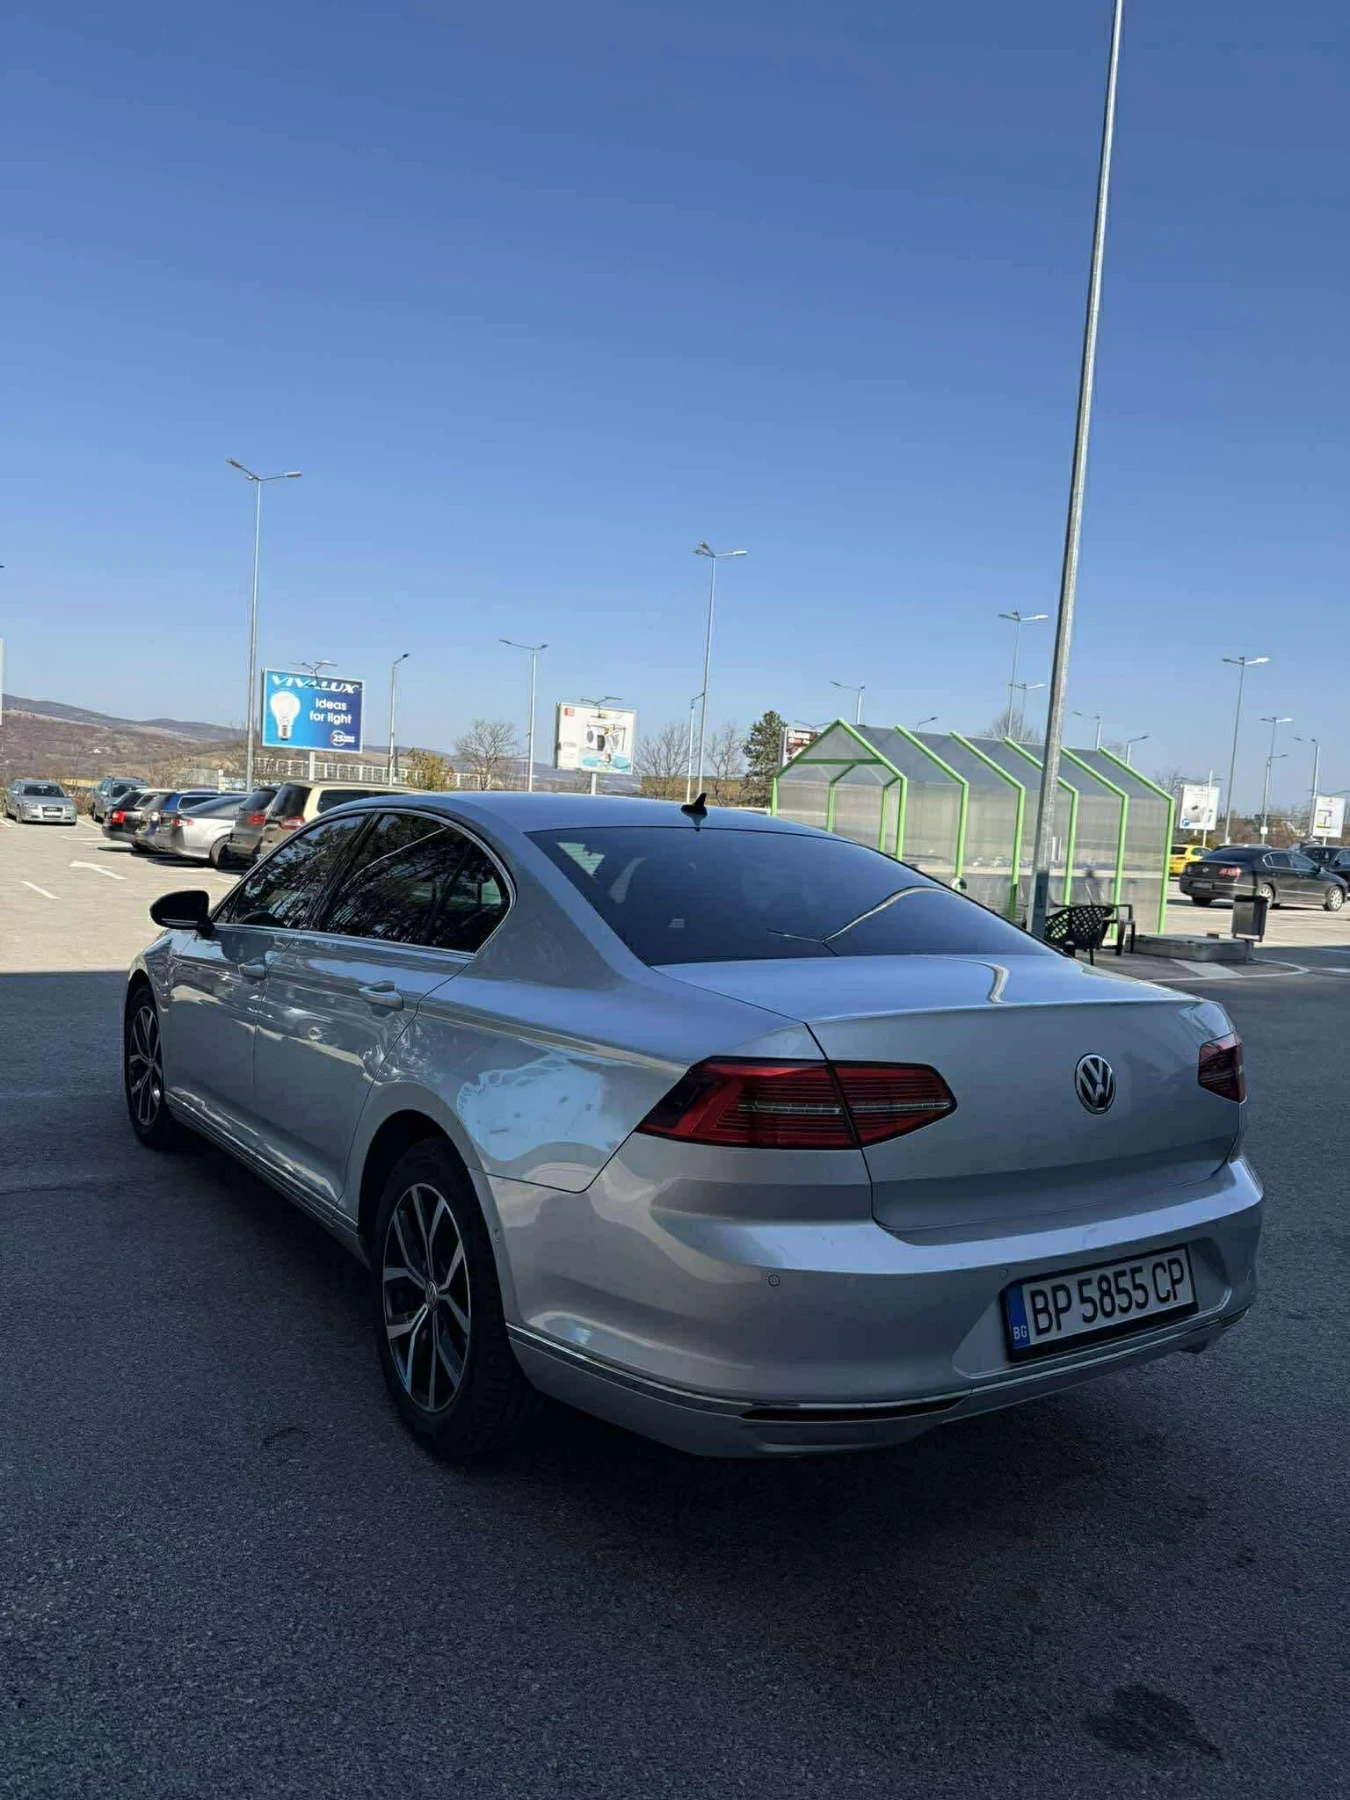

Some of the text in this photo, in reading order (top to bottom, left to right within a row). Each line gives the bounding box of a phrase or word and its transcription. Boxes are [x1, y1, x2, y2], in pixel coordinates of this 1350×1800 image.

[272, 674, 360, 694] VIVALUX
[309, 710, 352, 725] for light
[1012, 1325, 1028, 1341] BG
